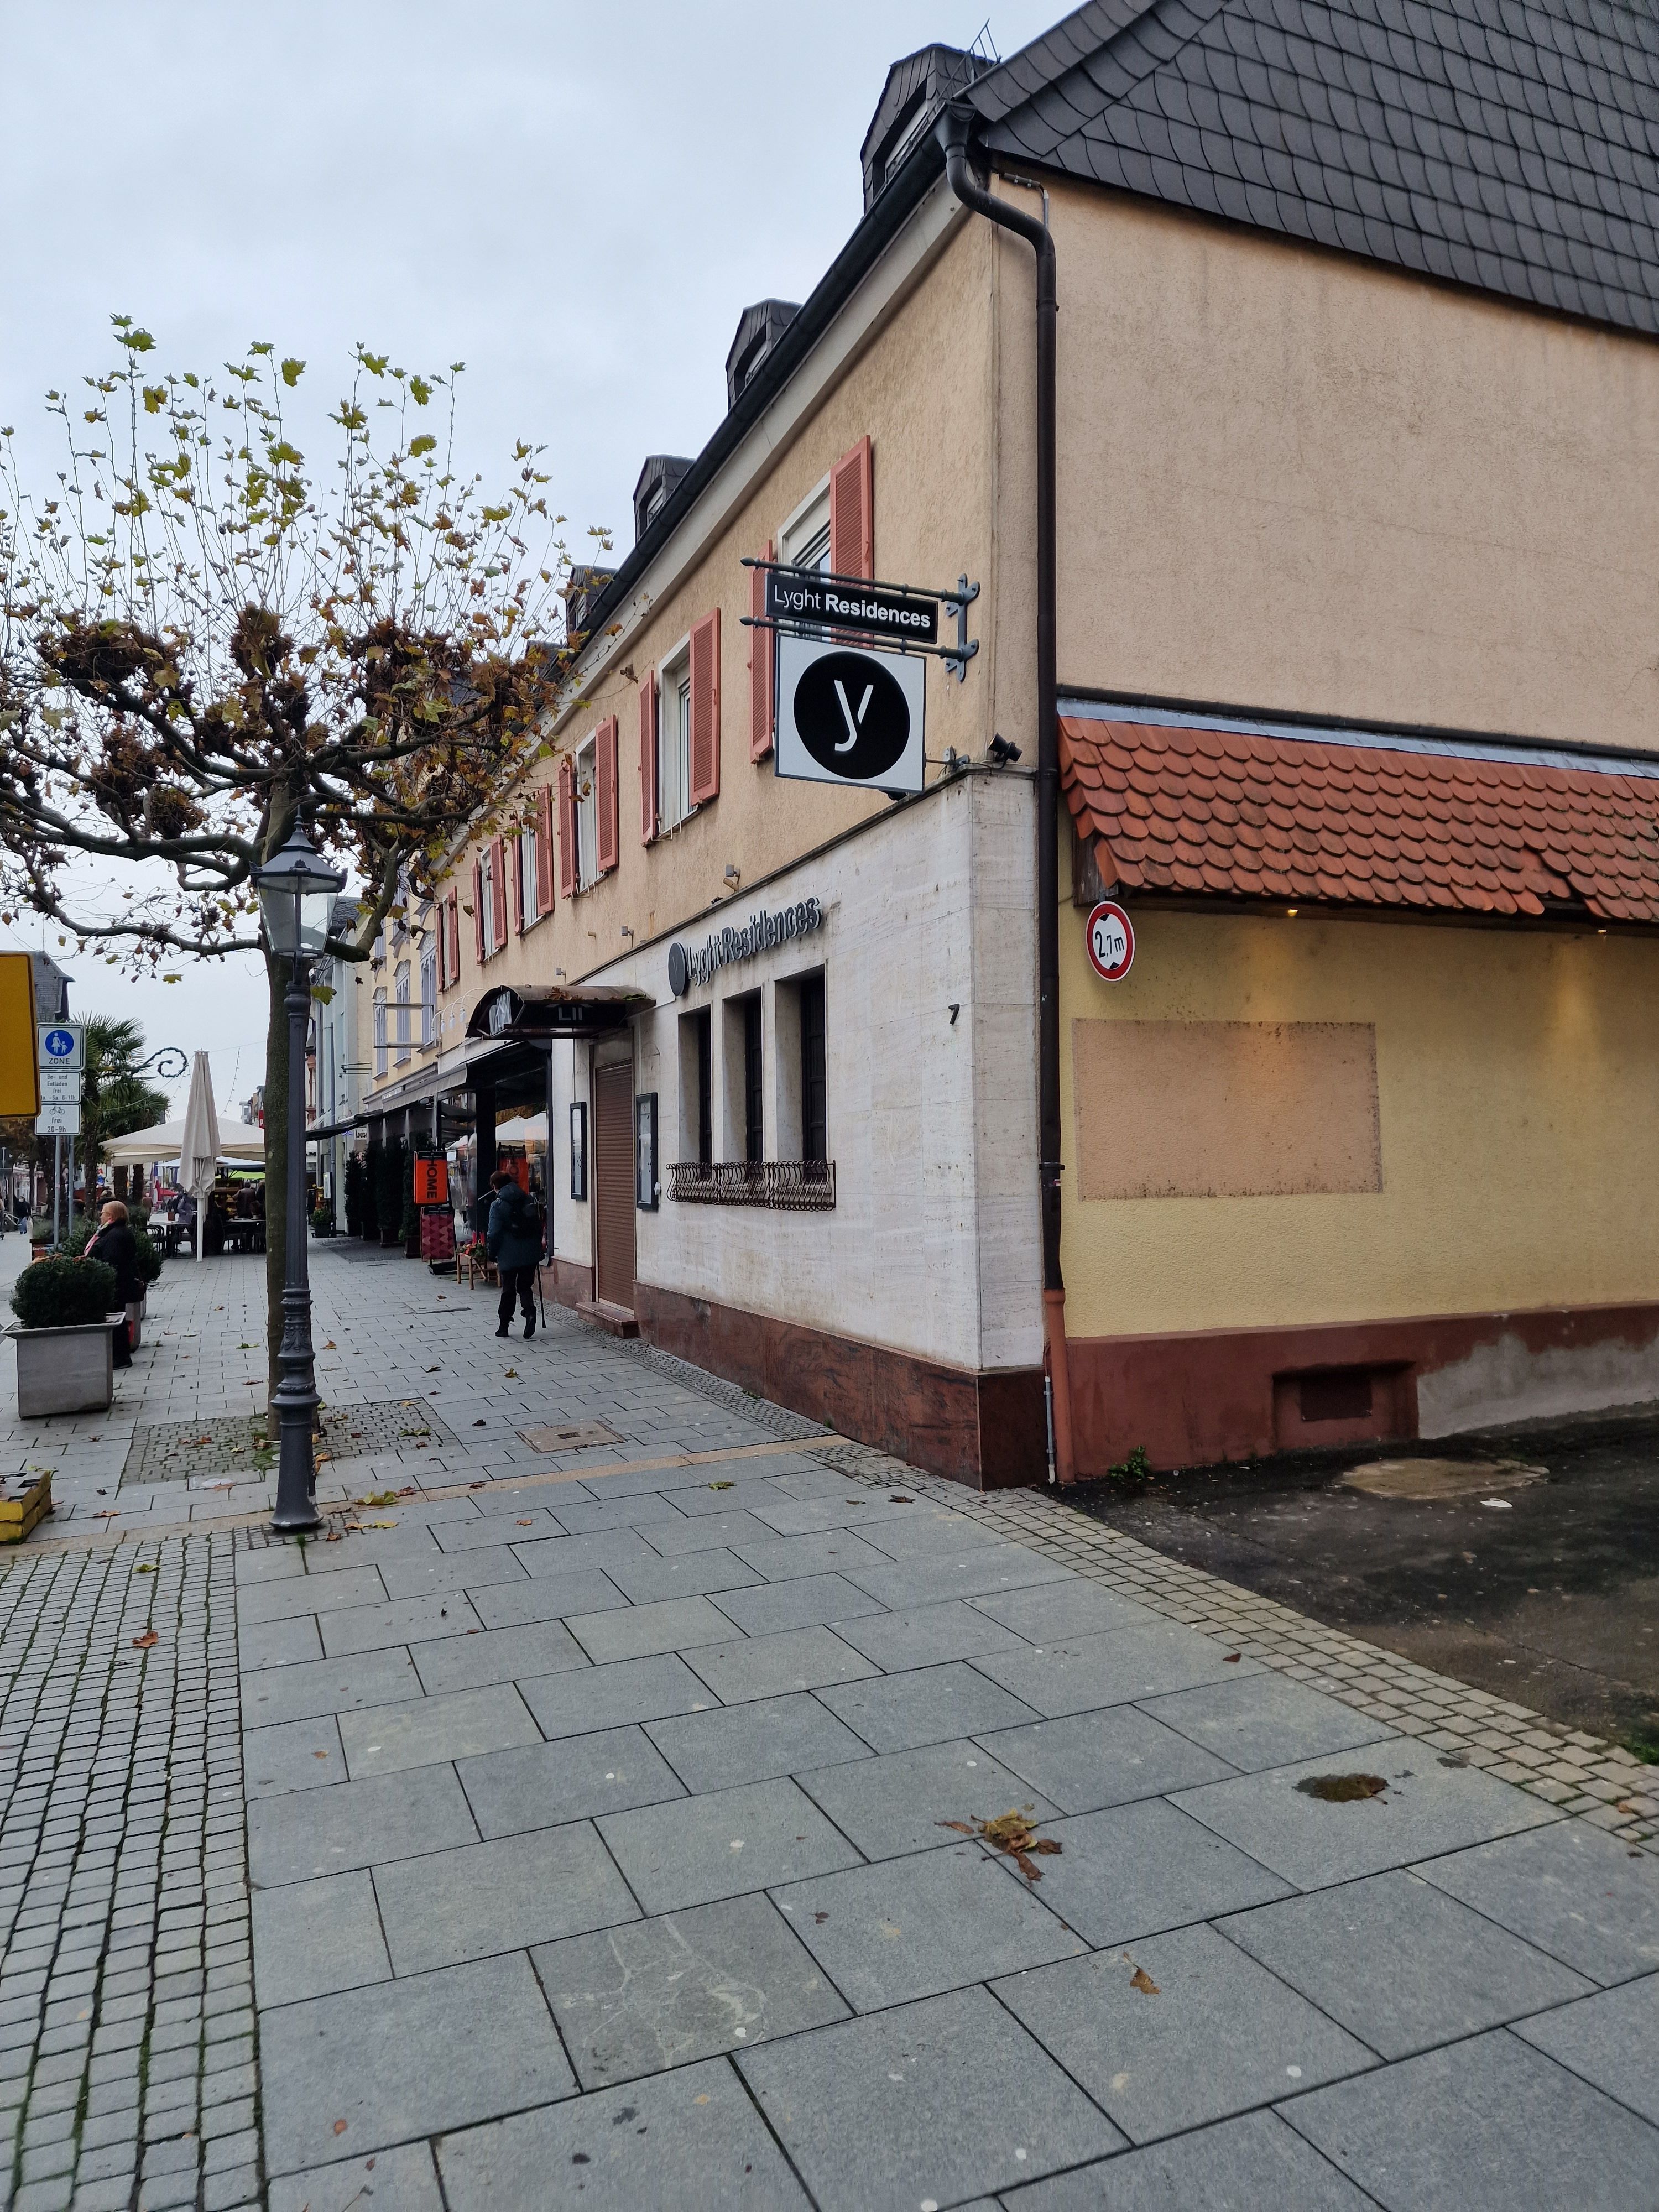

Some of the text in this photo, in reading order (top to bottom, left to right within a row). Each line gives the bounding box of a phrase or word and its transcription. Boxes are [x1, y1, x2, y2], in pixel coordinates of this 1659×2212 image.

[774, 584, 931, 628] Lyght Residences
[686, 935, 722, 987] Lyght
[721, 897, 822, 964] Residences
[427, 1159, 437, 1199] HOME
